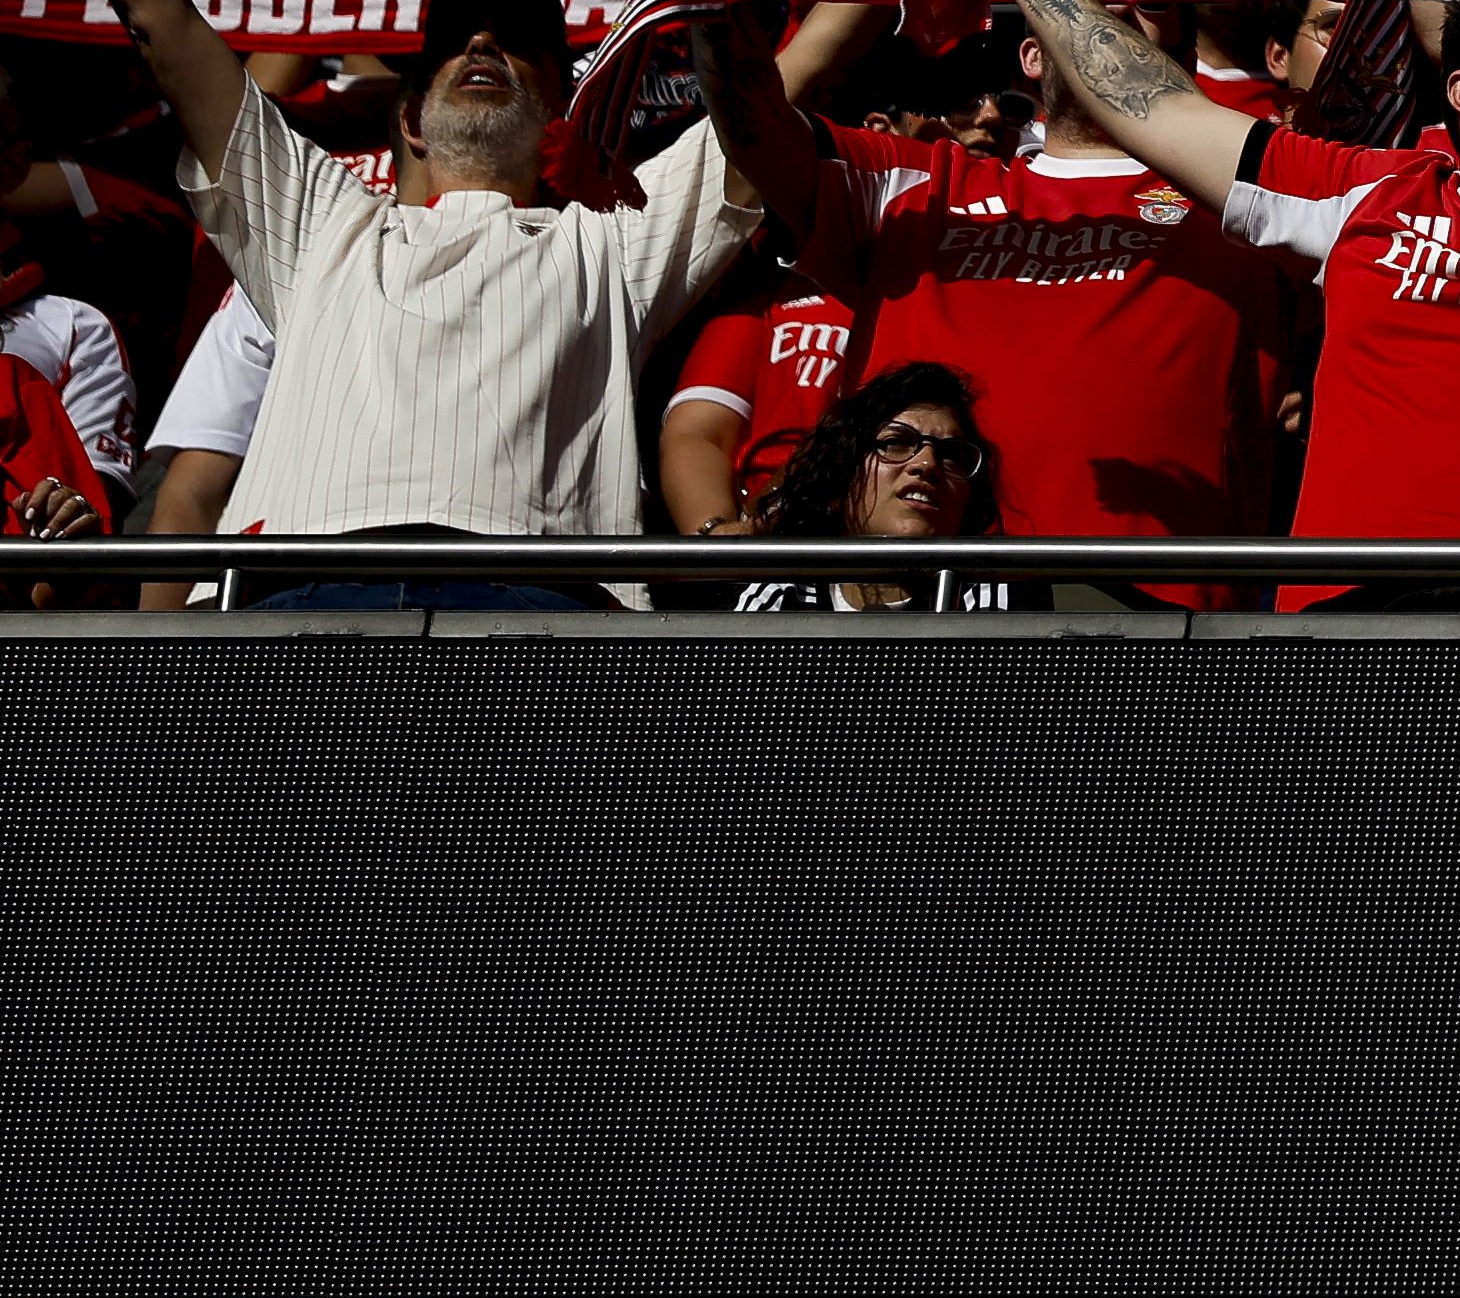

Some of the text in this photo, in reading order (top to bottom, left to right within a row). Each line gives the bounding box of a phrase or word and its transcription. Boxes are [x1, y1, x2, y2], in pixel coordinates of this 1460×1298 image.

[936, 220, 1173, 258] Emirates
[955, 251, 1133, 286] FLY BETTER
